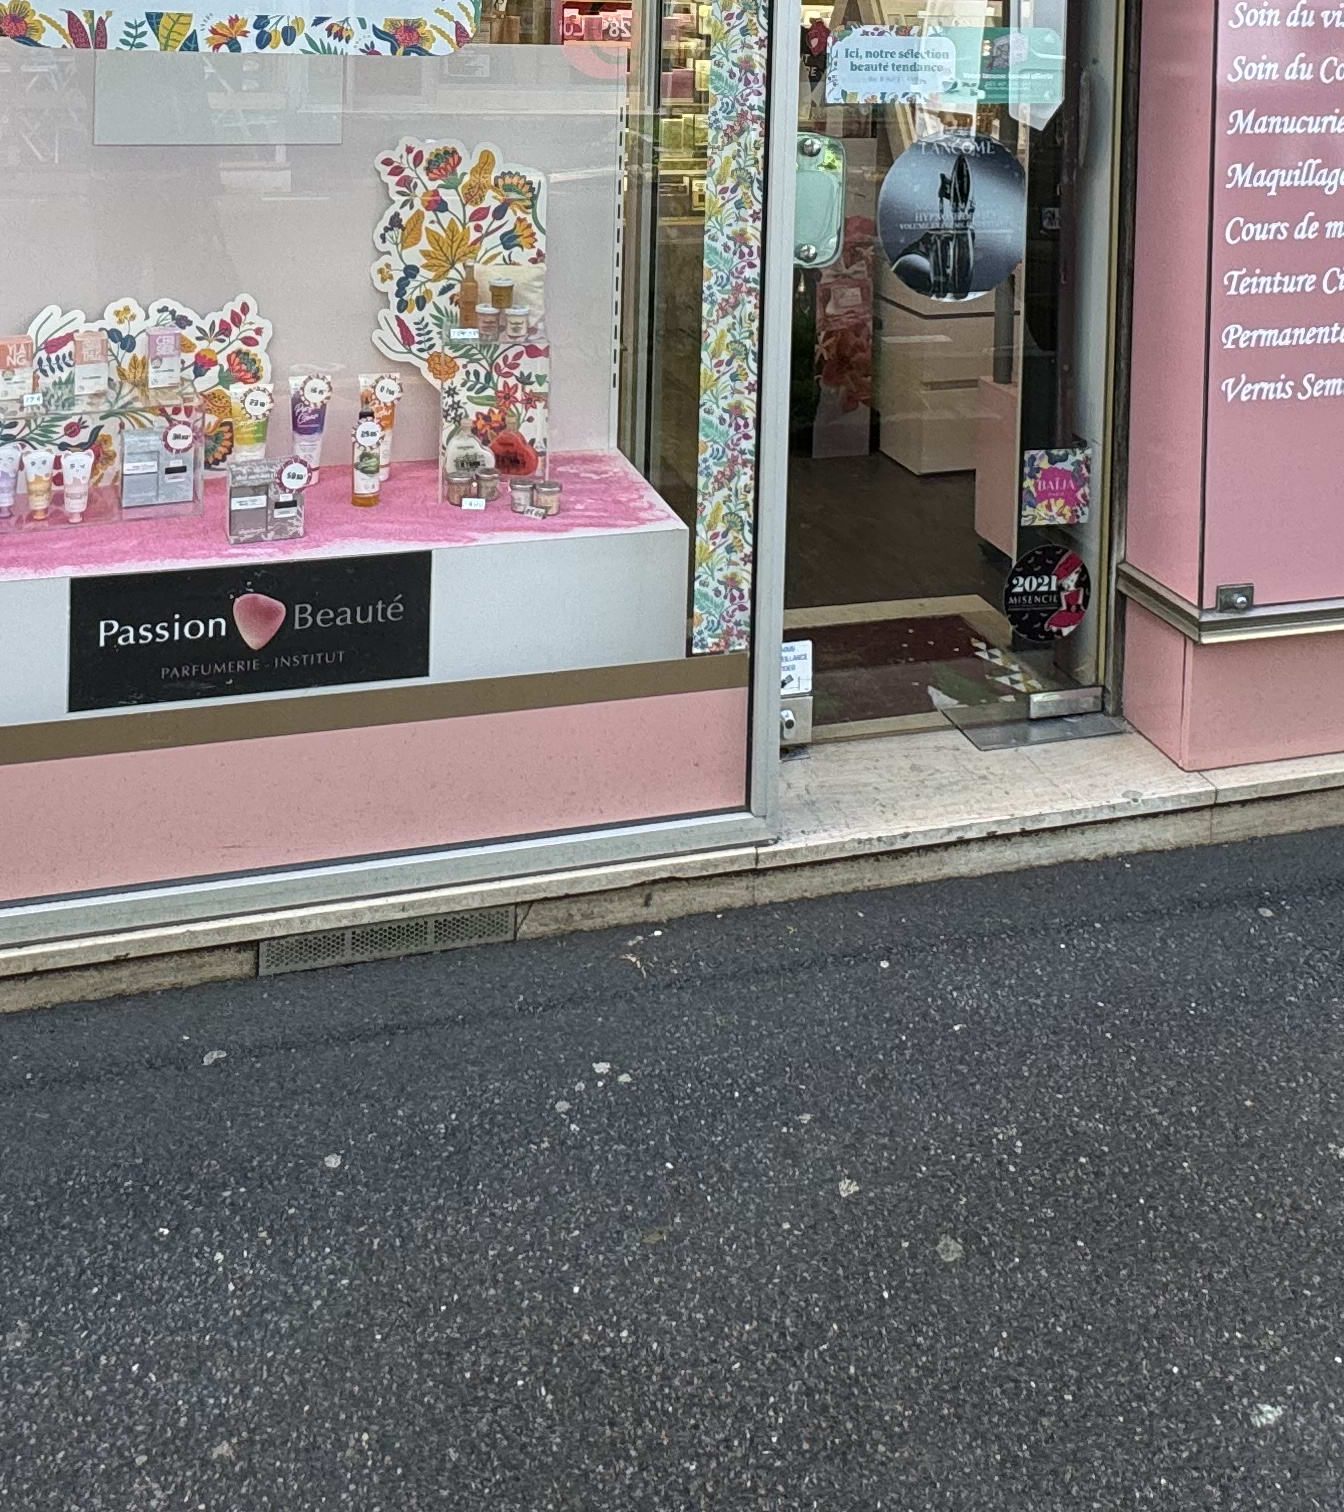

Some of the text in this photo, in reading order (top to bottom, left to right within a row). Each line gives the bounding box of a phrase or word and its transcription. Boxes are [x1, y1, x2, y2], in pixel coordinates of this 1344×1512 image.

[1228, 1, 1281, 29] Soin
[1286, 0, 1316, 28] du
[844, 48, 950, 60] Ici, notre sélection
[850, 61, 944, 73] beauté tendance
[1227, 55, 1279, 82] Soin
[1284, 52, 1314, 81] du
[1225, 216, 1288, 244] Cours
[1293, 210, 1318, 240] de
[1223, 268, 1317, 296] Teinture
[1221, 374, 1295, 403] Vernis
[1011, 575, 1057, 593] 2021
[98, 593, 405, 648] Passion Beauté
[160, 658, 261, 680] PARFUMERIE
[274, 650, 346, 670] INSTITUT
